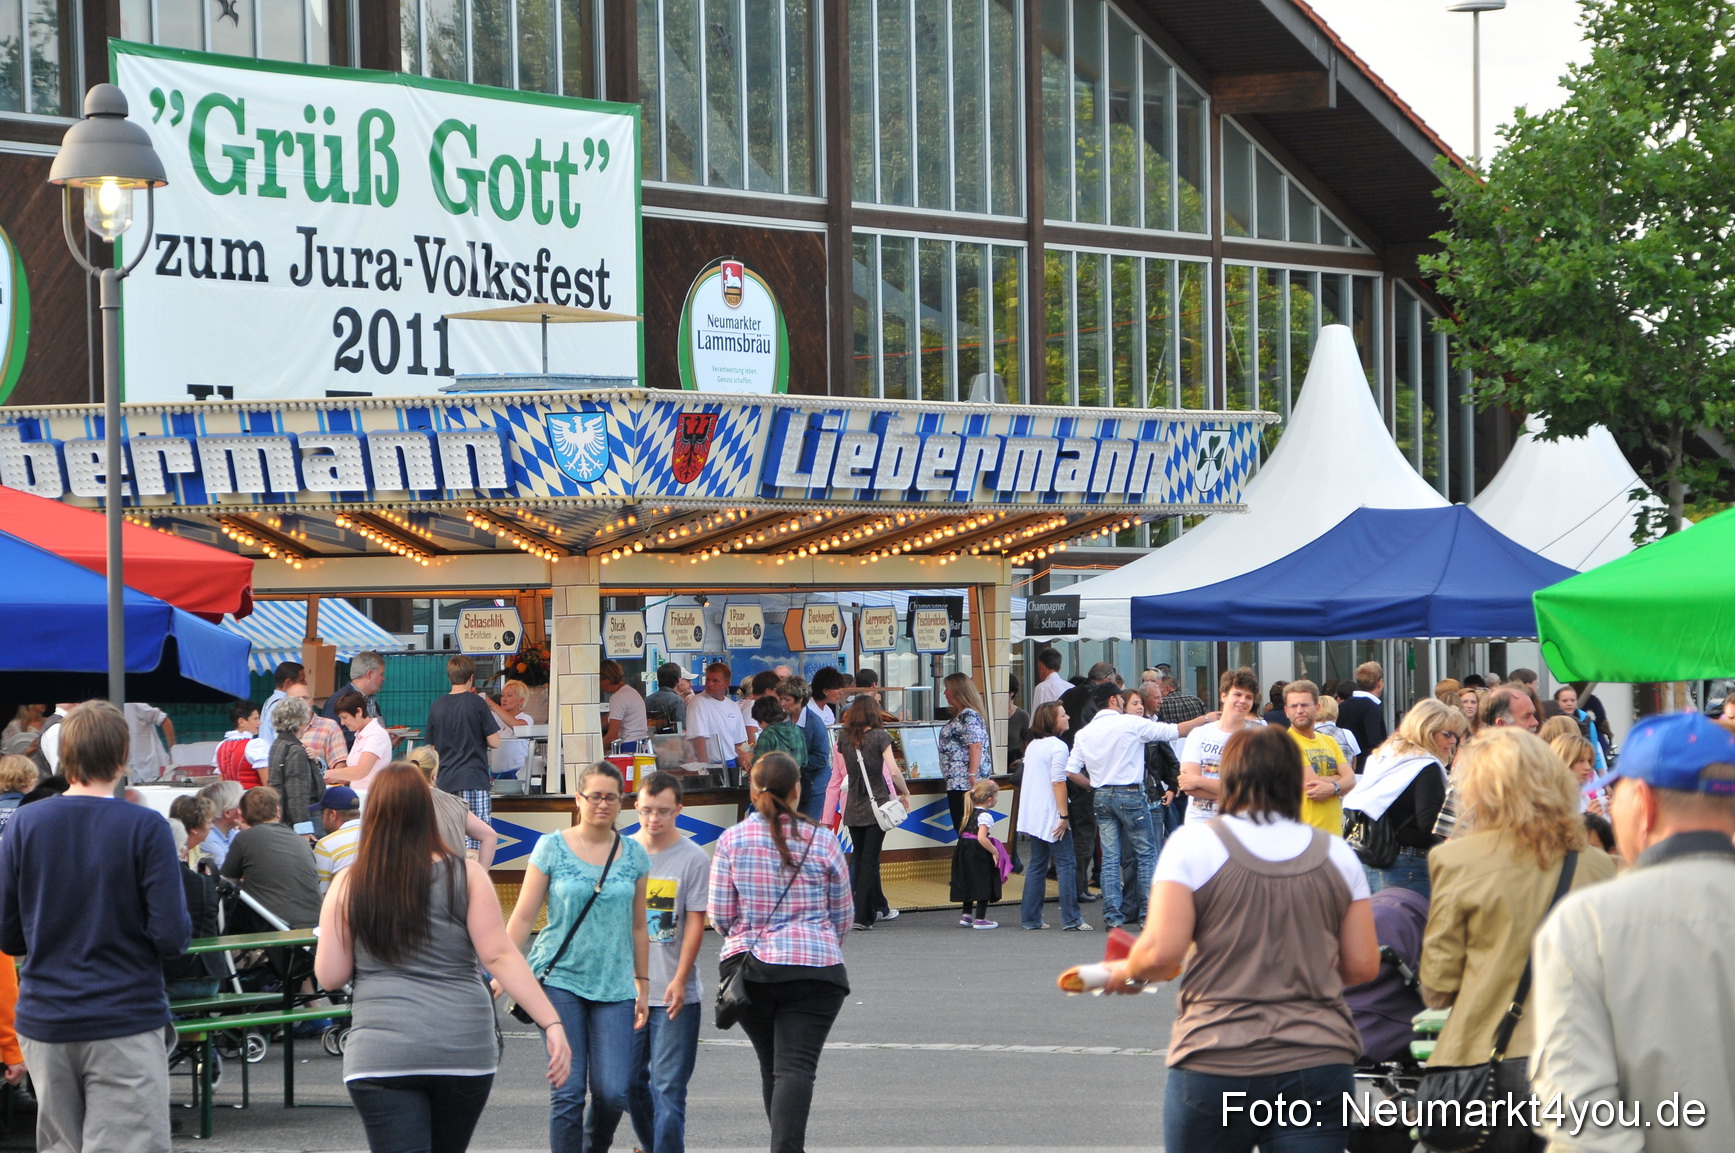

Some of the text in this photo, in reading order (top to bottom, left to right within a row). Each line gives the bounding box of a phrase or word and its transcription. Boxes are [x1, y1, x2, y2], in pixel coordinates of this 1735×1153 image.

[155, 226, 611, 309] zum Jura-Volksfest
[707, 314, 762, 331] Neumarkter
[332, 307, 455, 376] 2011
[698, 330, 771, 354] Lammsbräu
[712, 365, 758, 375] Verantwortung leben.
[734, 377, 753, 385] schaffen.
[774, 410, 1170, 494] Liebermann
[1027, 601, 1066, 614] Champagner
[464, 613, 505, 629] Schaschlik
[671, 611, 695, 626] Frikadelle
[733, 610, 745, 621] Paar
[808, 609, 835, 623] Bockwurst
[865, 611, 893, 627] Currywurst
[610, 617, 627, 632] Steak
[1041, 618, 1066, 631] Schnaps
[1067, 618, 1079, 628] Bar
